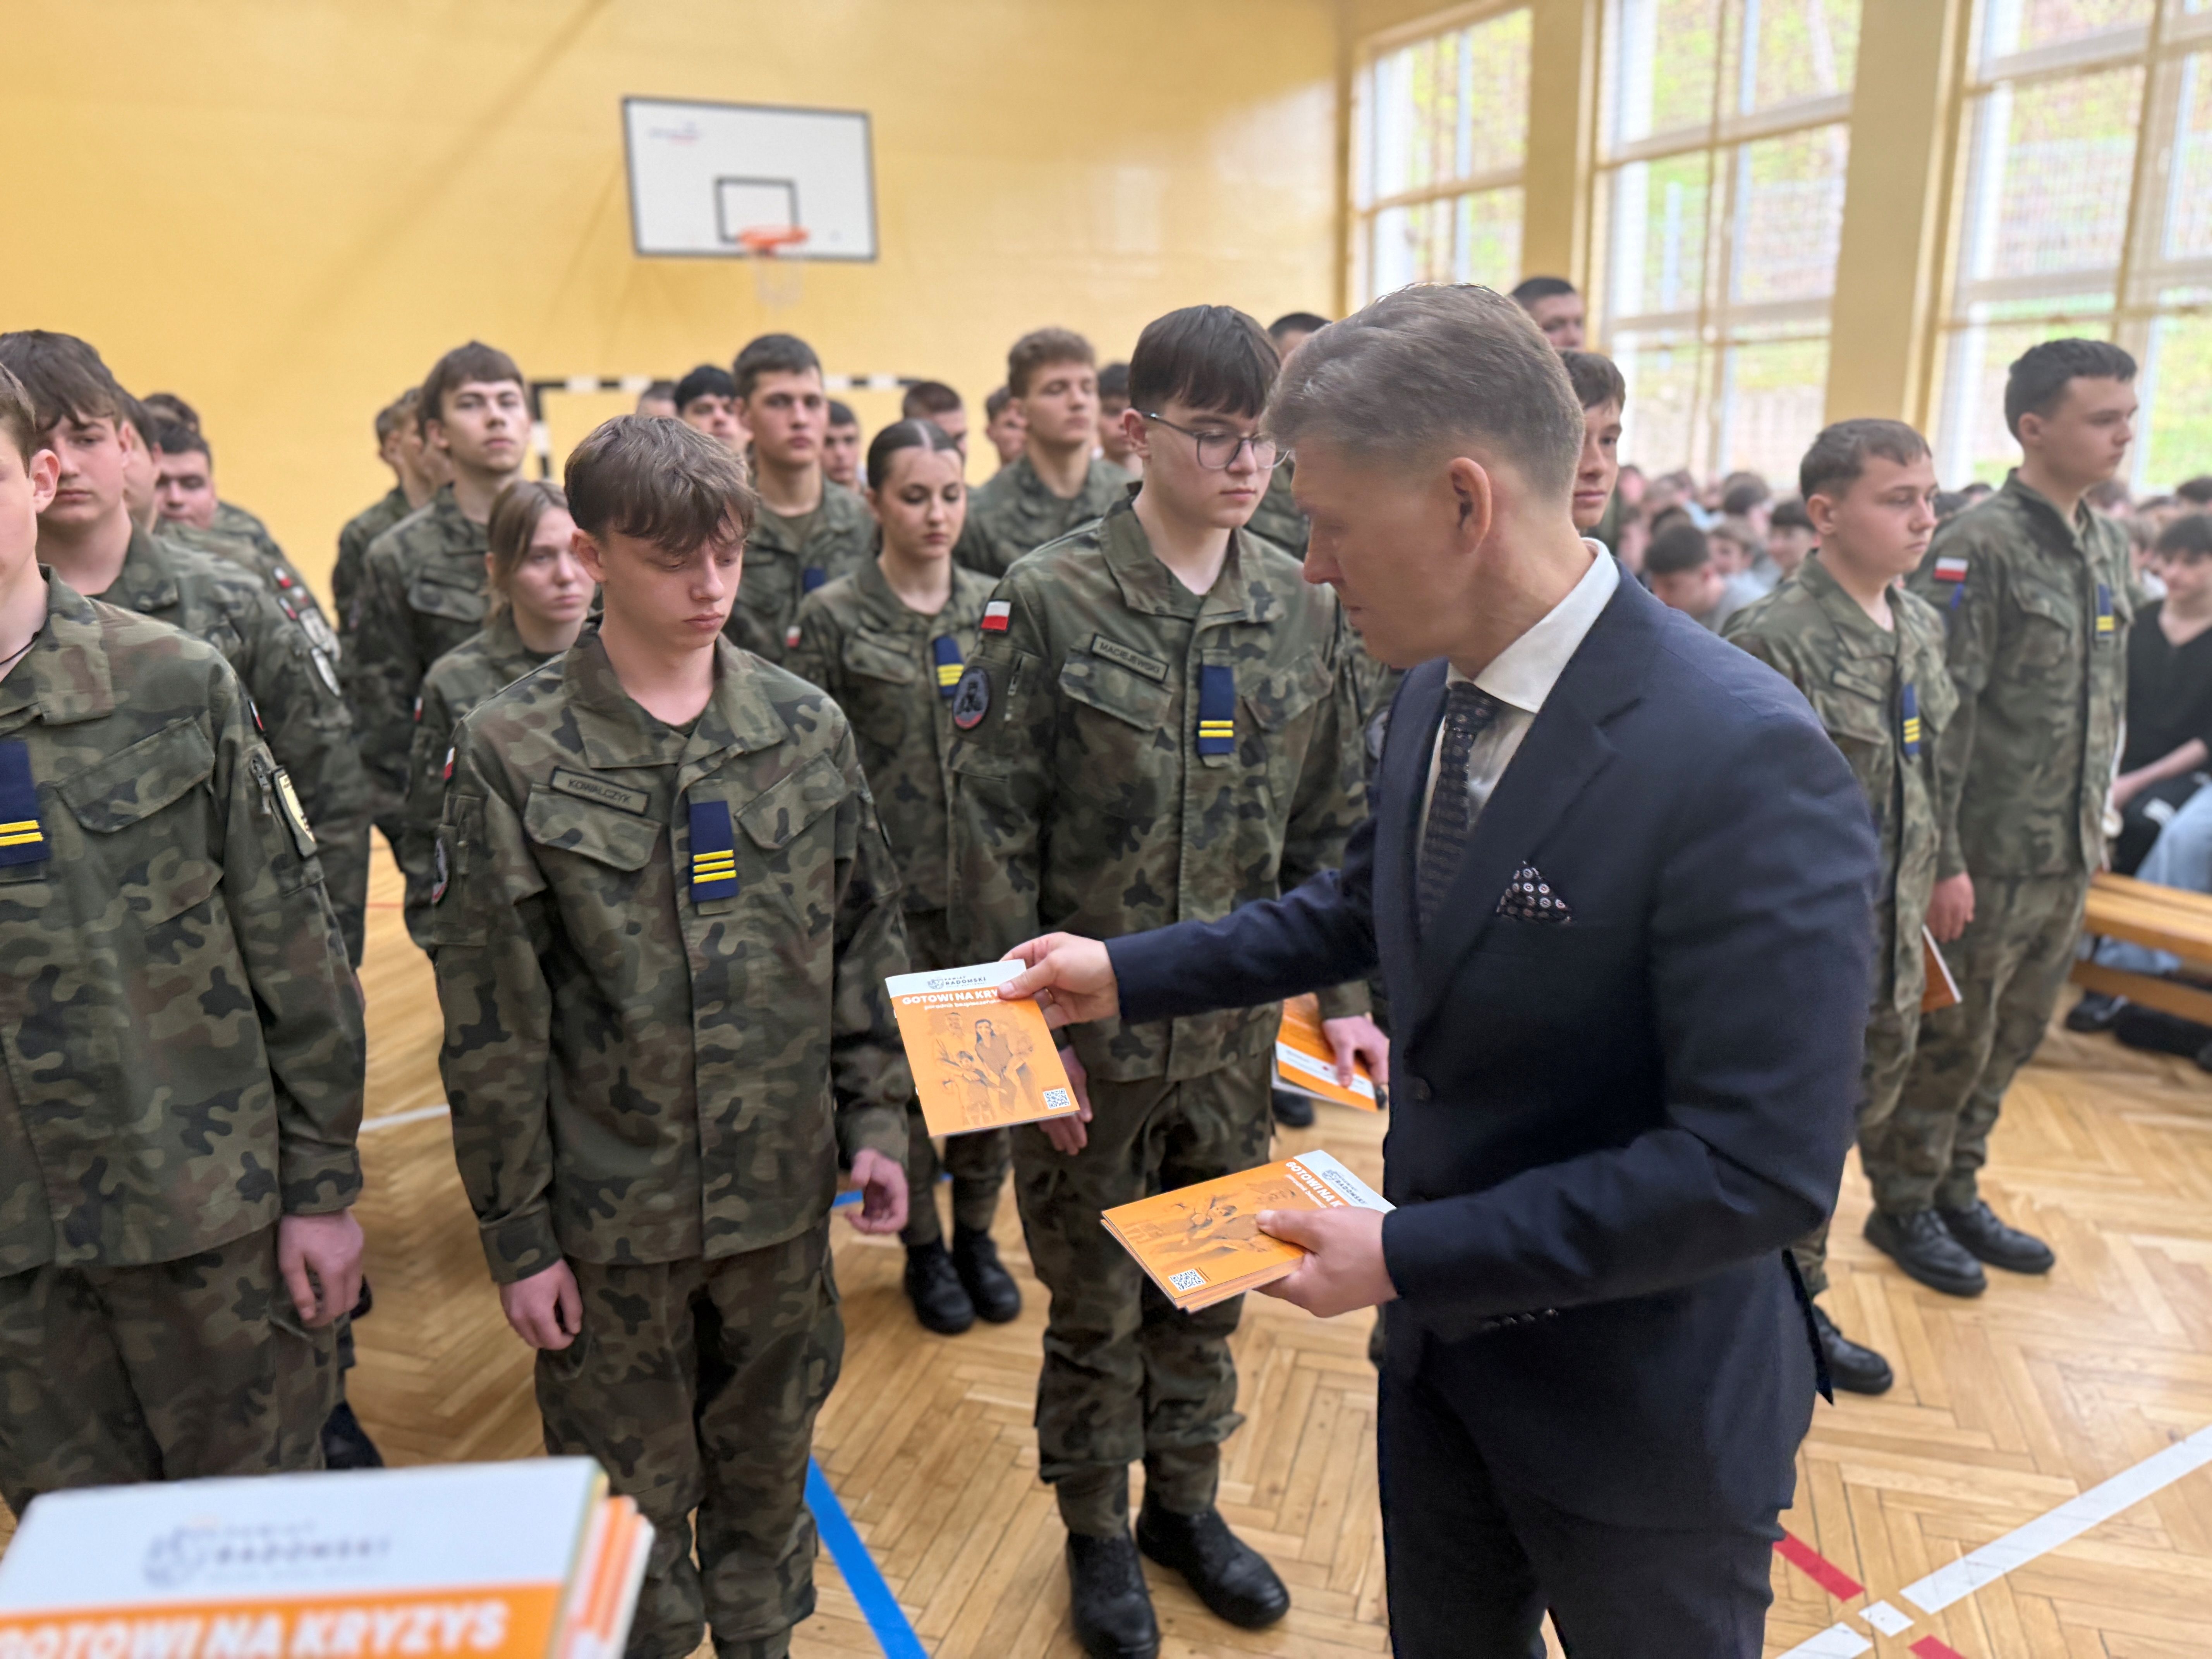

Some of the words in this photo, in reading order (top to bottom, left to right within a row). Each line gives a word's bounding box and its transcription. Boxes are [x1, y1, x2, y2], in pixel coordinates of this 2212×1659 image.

[568, 778, 632, 804] KOWALCZYK
[945, 977, 986, 985] RADOMSKI
[902, 993, 954, 1005] GOTOWI
[955, 991, 974, 1001] NA
[974, 989, 998, 999] KRY
[1285, 1161, 1324, 1190] GOTOWI
[1317, 1188, 1335, 1202] NA
[202, 1609, 282, 1659] NA
[290, 1599, 510, 1658] KRYZYS
